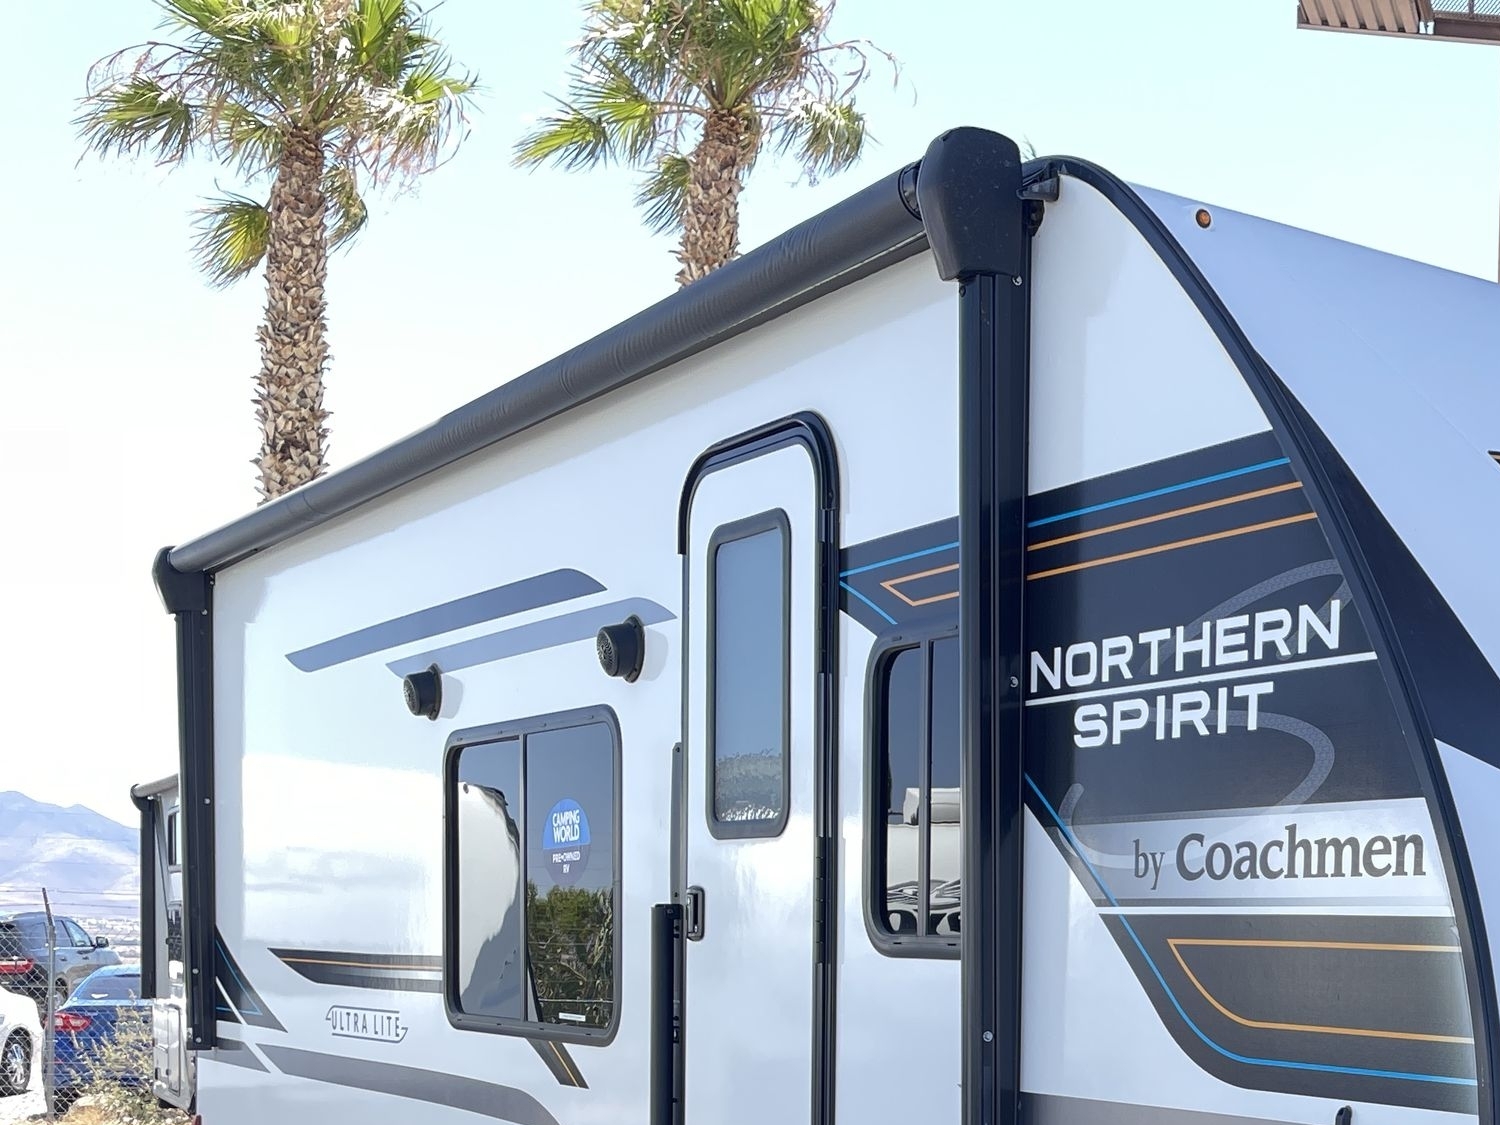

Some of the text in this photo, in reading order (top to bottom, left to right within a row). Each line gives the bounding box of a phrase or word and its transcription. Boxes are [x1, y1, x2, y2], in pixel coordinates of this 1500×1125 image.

[1029, 599, 1341, 693] NORTHERN
[1073, 681, 1274, 749] SPIRIT
[552, 809, 580, 827] CAMPING
[553, 824, 580, 843] WORLD
[1133, 823, 1427, 890] by Coachmen
[331, 1010, 400, 1037] ULTRA LITE
